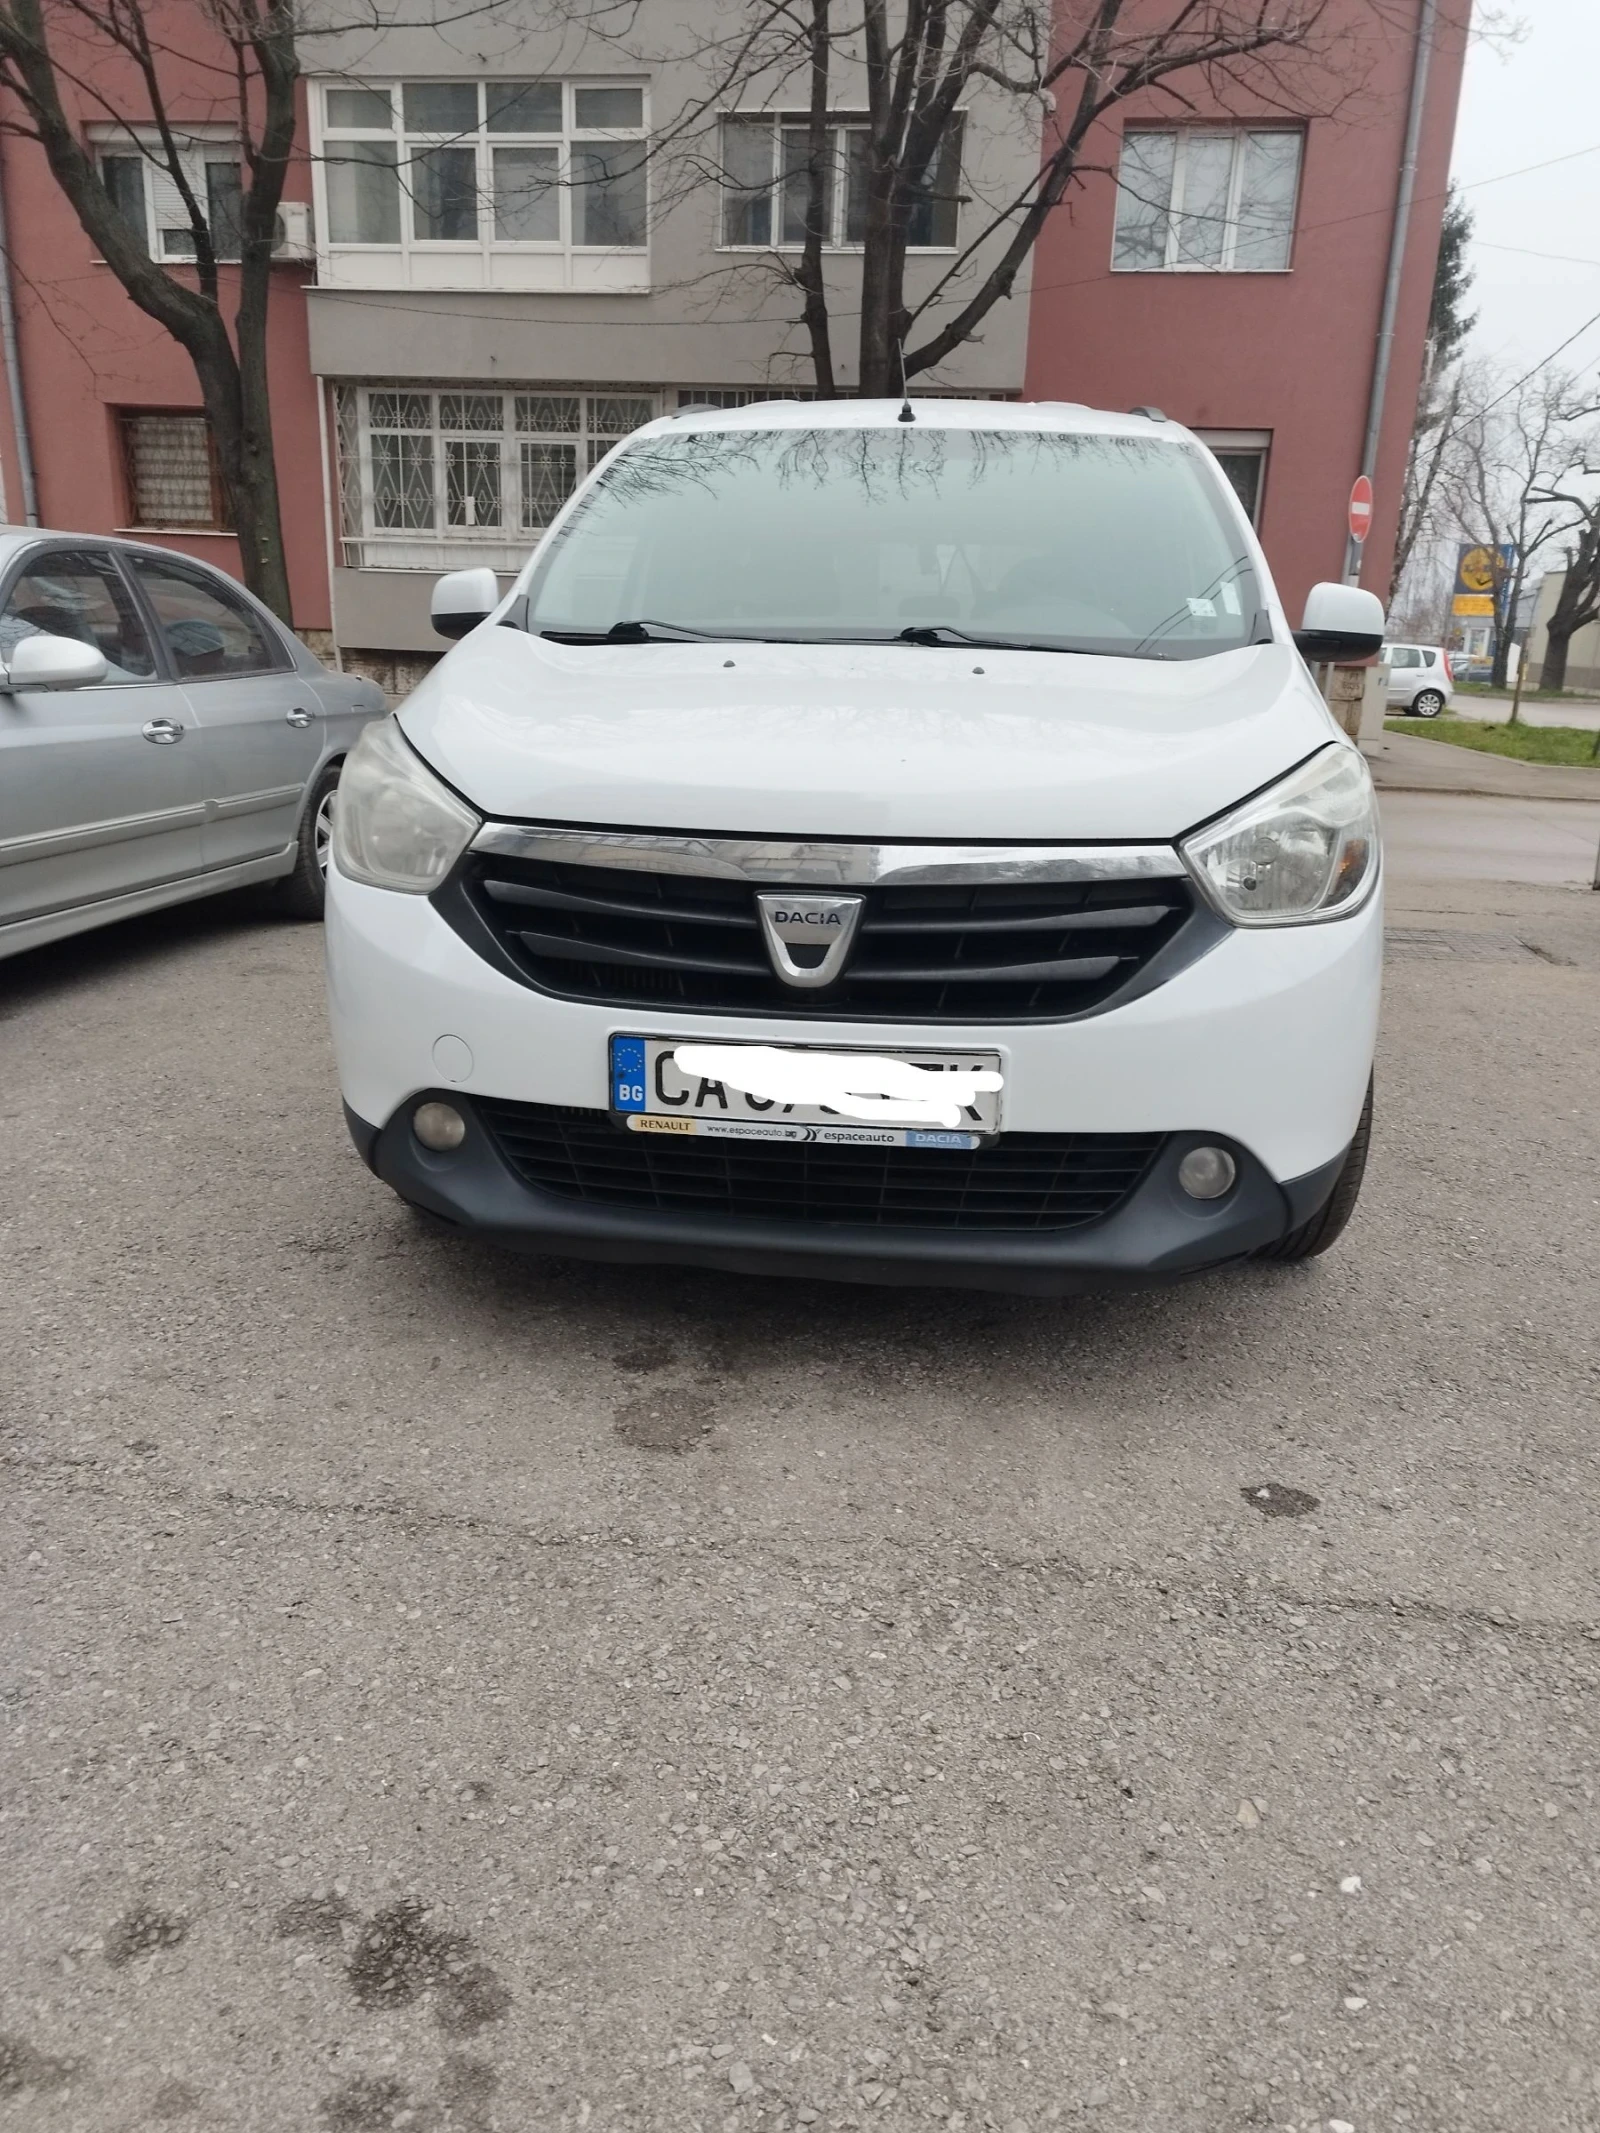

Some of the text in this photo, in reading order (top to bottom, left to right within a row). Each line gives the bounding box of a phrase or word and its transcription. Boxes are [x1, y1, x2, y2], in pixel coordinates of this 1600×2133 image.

[774, 911, 842, 926] DACIA
[619, 1084, 643, 1101] BG
[640, 1119, 691, 1131] RENAULT
[824, 1132, 895, 1143] espaceauto
[915, 1133, 962, 1144] DACIA
